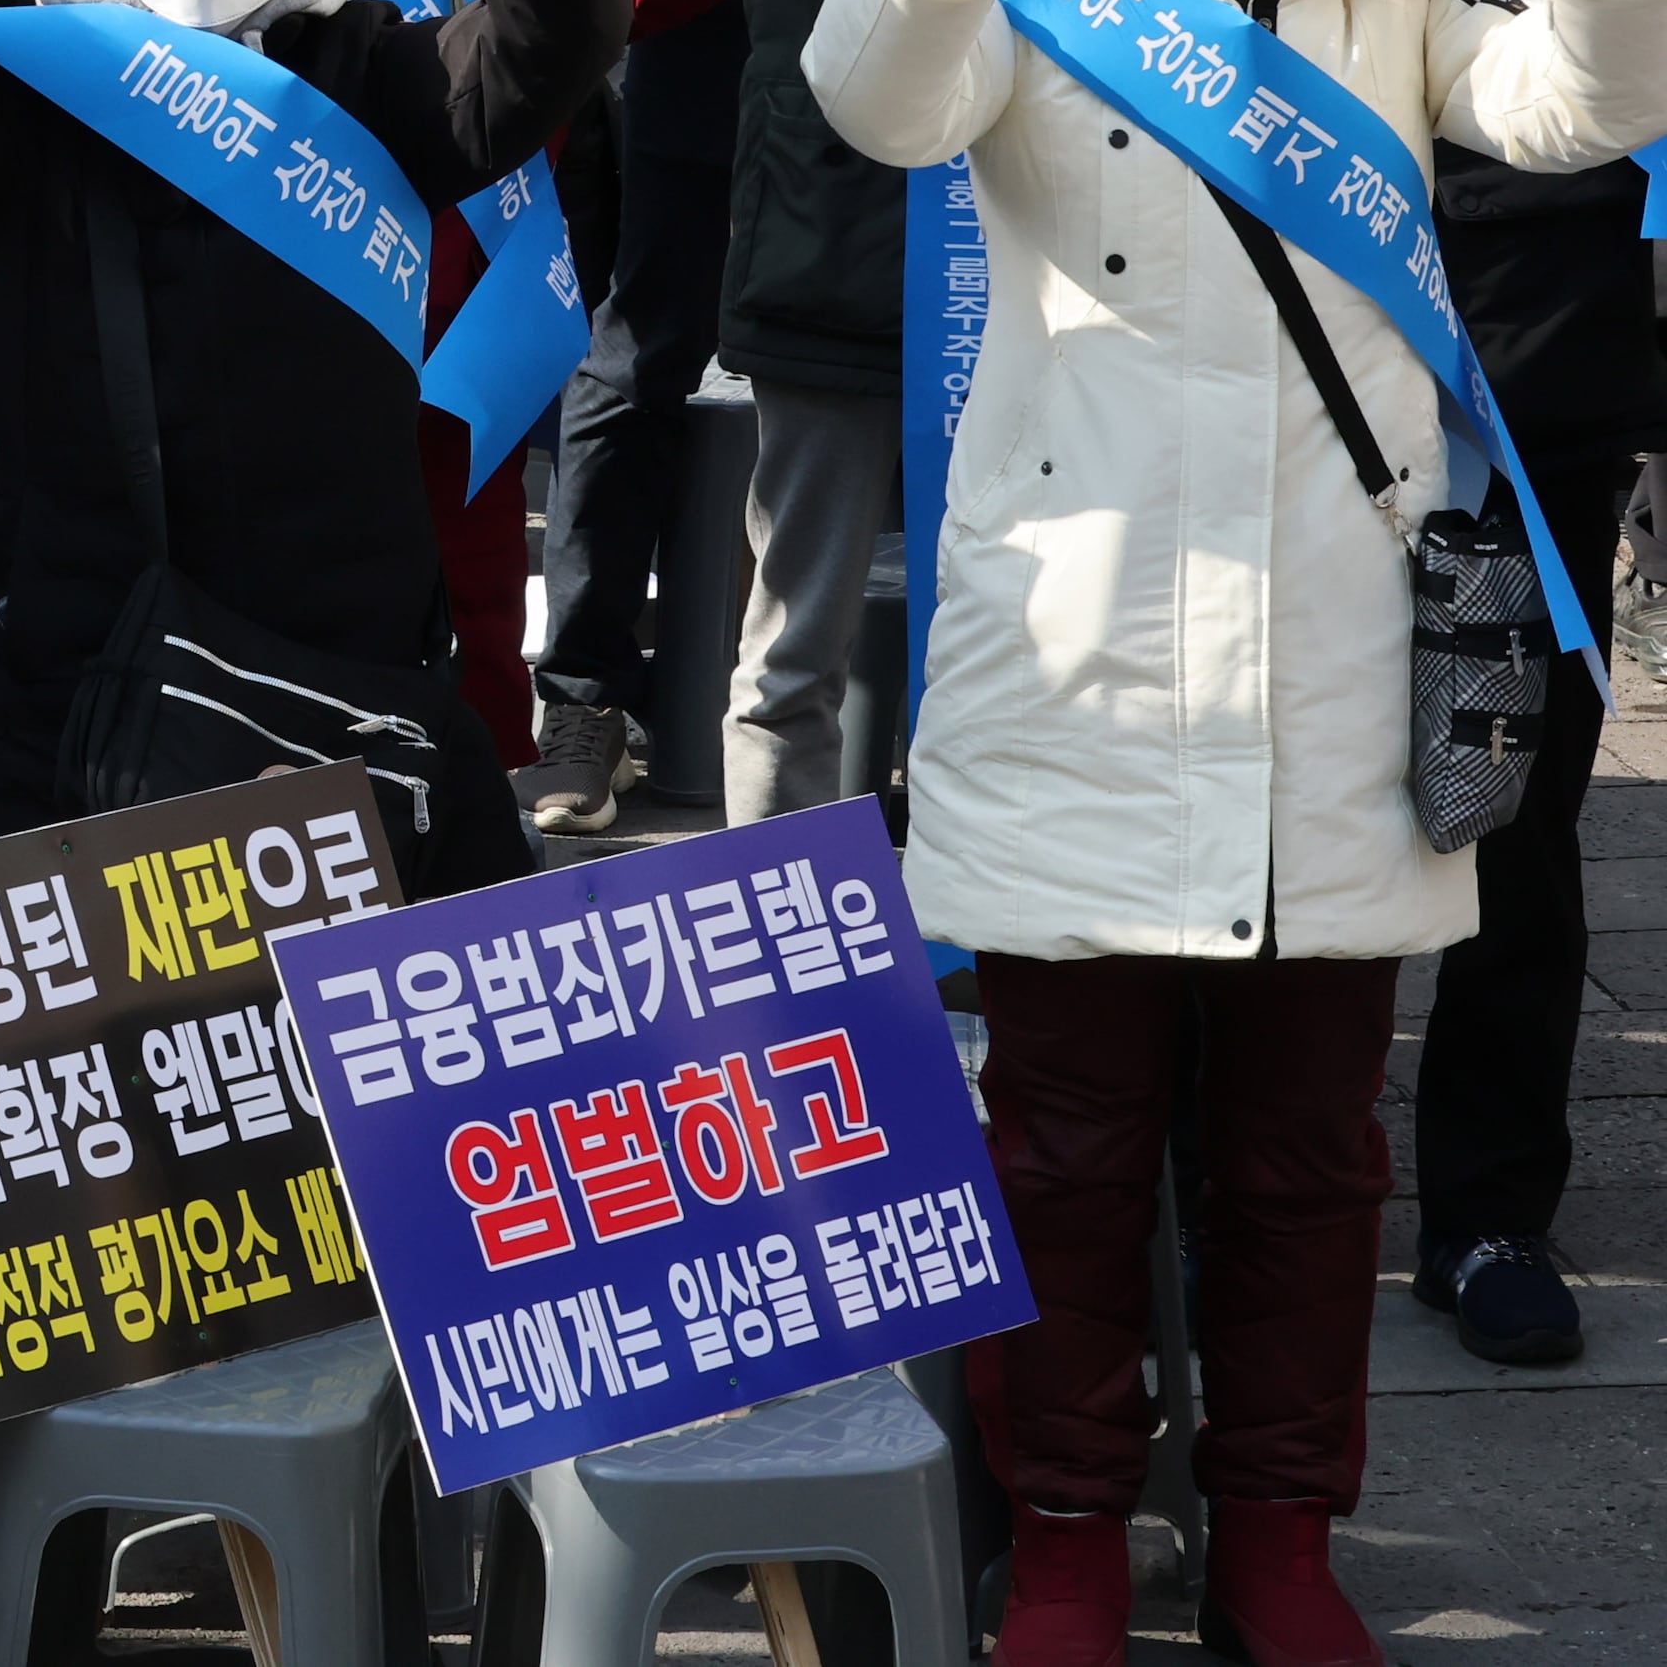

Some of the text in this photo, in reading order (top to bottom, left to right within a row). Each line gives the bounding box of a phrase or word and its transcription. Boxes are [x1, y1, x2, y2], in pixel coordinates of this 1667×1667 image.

[121, 38, 278, 164] 금융위
[1137, 8, 1238, 108] 상장
[444, 1026, 890, 1272] 엄벌하고
[88, 1187, 292, 1344] 평가요소
[424, 1181, 1003, 1437] 시민에게는 일상을 돌려달라
